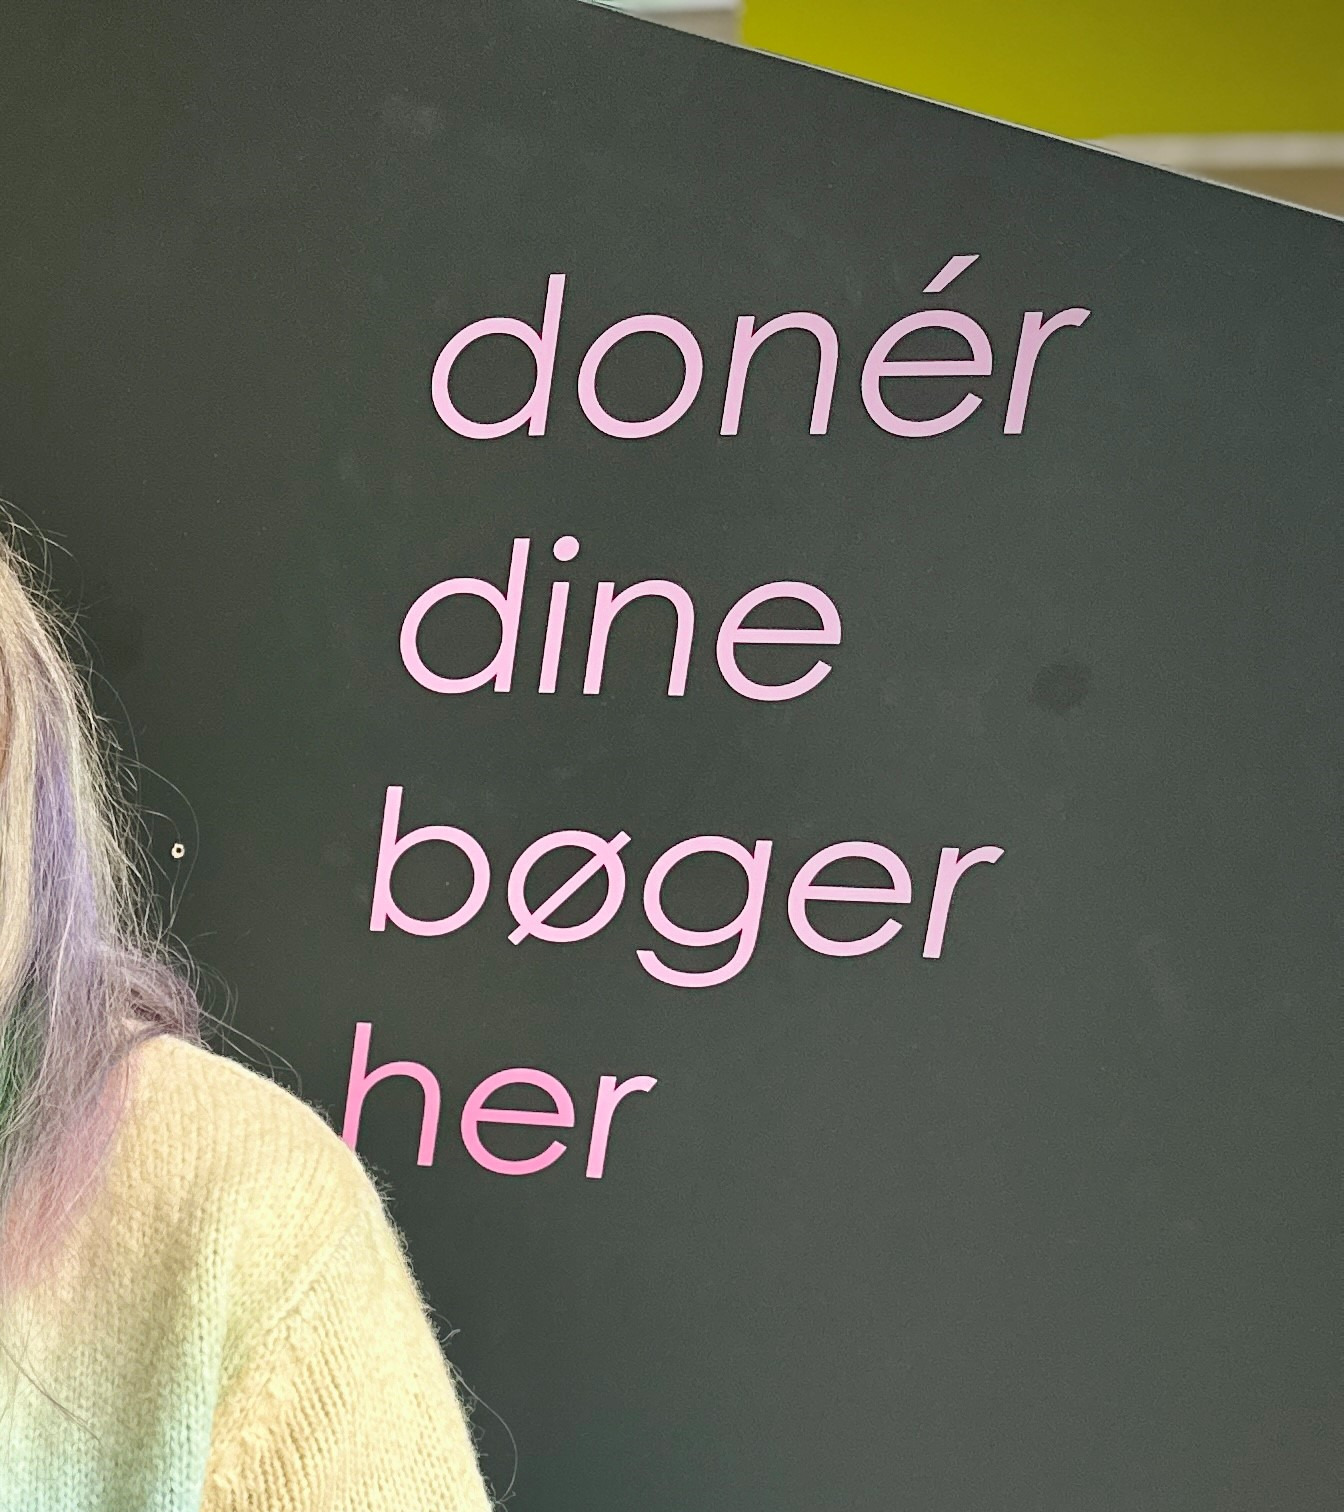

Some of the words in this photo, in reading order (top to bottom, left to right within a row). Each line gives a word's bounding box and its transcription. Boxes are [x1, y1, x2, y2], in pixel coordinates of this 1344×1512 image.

[431, 254, 1091, 440] donér
[398, 535, 841, 702] dine
[370, 785, 1004, 988] bøger
[343, 1022, 658, 1179] her
